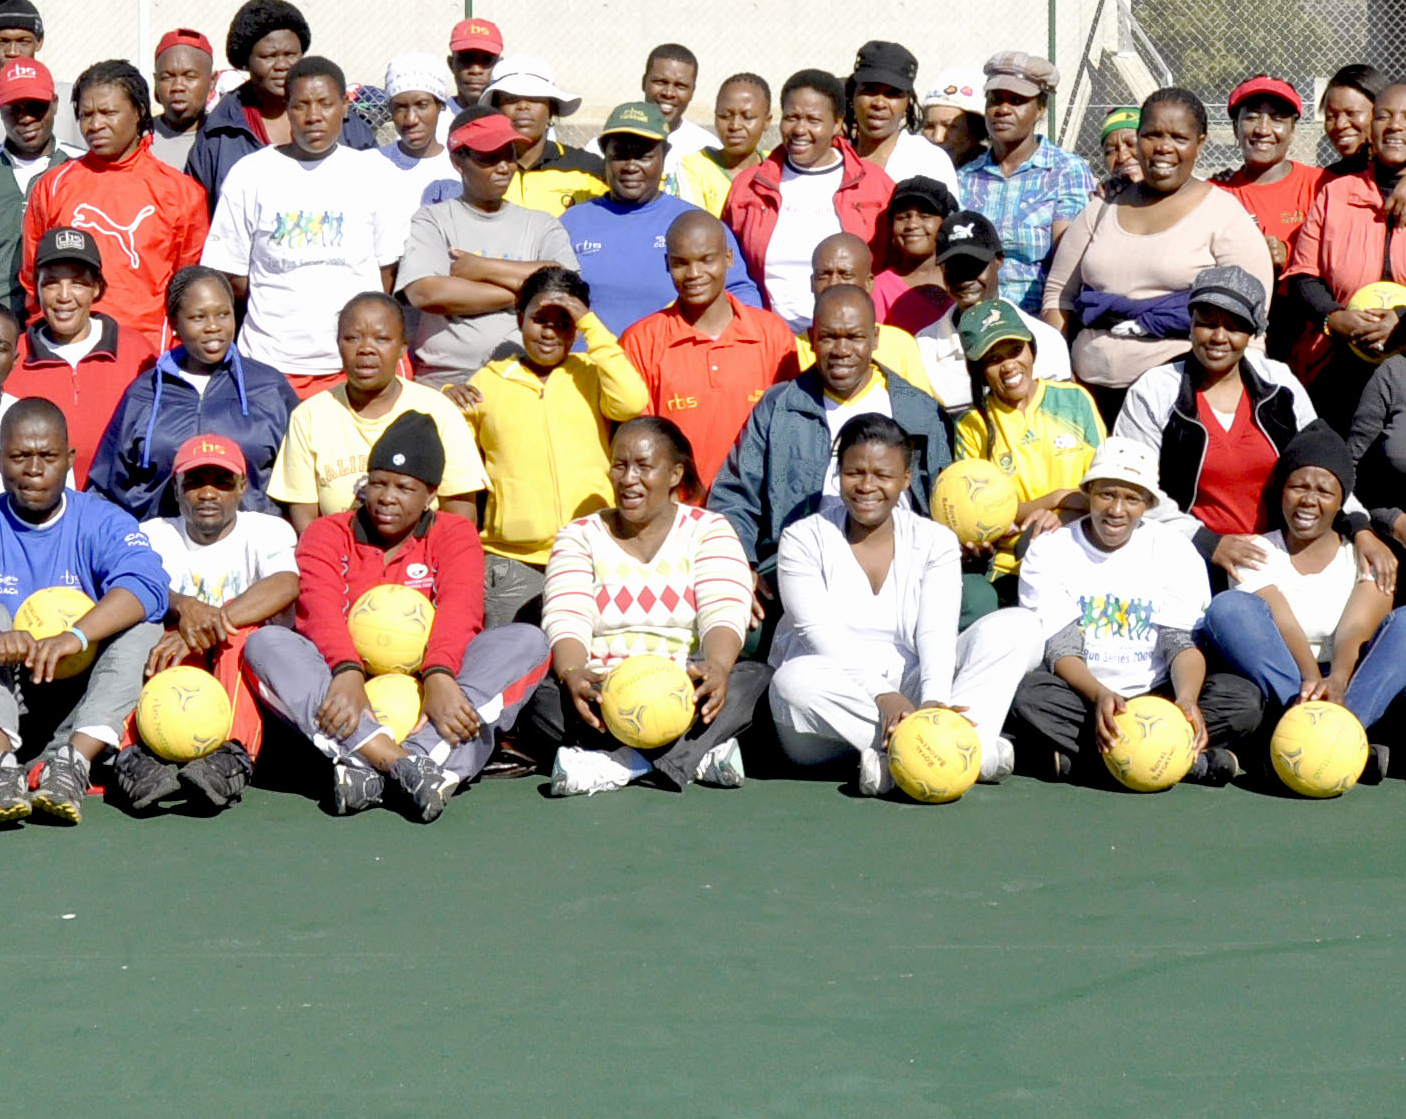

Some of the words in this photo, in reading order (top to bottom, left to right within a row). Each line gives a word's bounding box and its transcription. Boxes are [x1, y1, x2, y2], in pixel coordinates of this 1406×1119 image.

[667, 393, 697, 411] rbs
[193, 441, 225, 456] rbs
[914, 744, 935, 768] ROYAL
